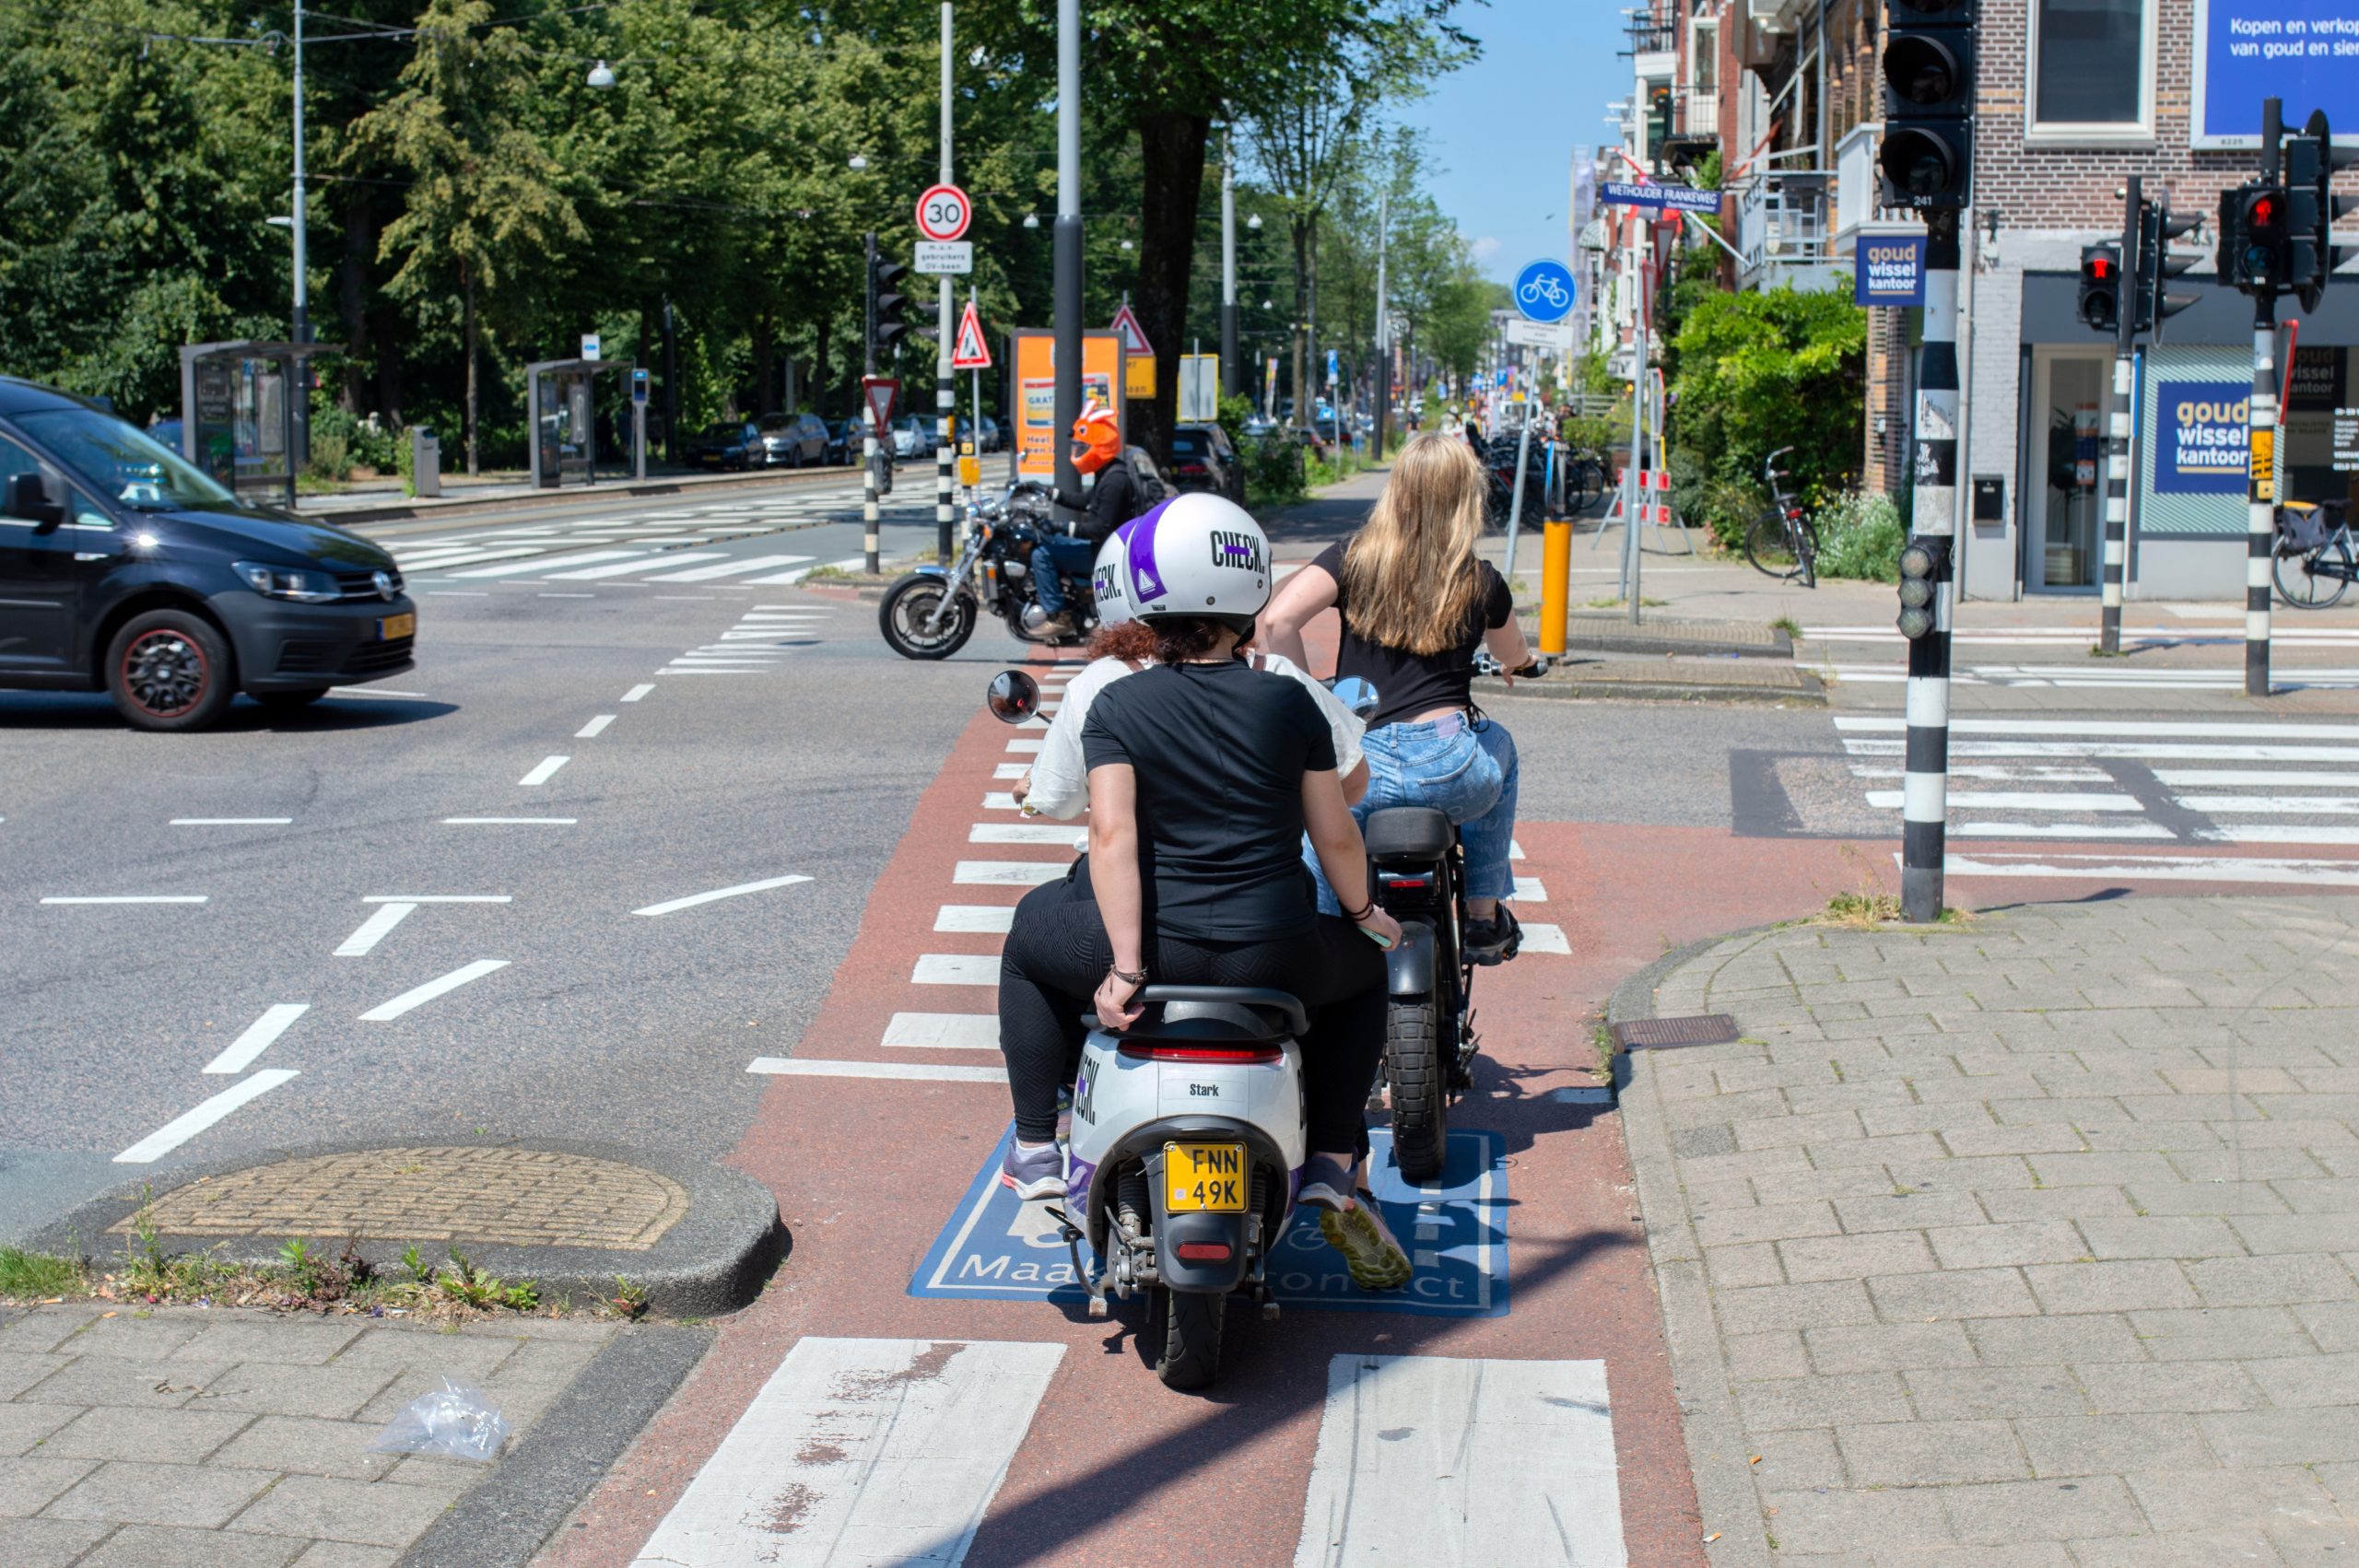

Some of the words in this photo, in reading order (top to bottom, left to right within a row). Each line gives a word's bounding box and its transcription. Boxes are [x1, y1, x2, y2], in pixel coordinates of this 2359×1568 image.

[2230, 18, 2282, 37] Kopen
[2285, 20, 2306, 34] en
[2230, 42, 2259, 56] van
[2263, 40, 2304, 59] goud
[2308, 42, 2329, 56] en
[1607, 183, 1662, 199] WETHOUDER
[1664, 188, 1718, 205] FRANKEWEG
[1914, 195, 1932, 205] 241
[929, 204, 960, 223] 30
[921, 253, 966, 262] gebruikers
[1868, 243, 1917, 263] goud
[1868, 261, 1917, 276] wissel
[1868, 276, 1917, 289] kantoor
[2295, 348, 2335, 364] oud
[2291, 381, 2335, 393] antoor
[1028, 396, 1053, 404] GRAT
[2177, 397, 2249, 427] goud
[2177, 423, 2249, 447] wissel
[2177, 446, 2249, 465] kantoor
[1210, 530, 1265, 575] CHECK.
[1190, 1083, 1219, 1097] Stark
[1192, 1149, 1238, 1175] FNN
[1192, 1179, 1238, 1205] 49K
